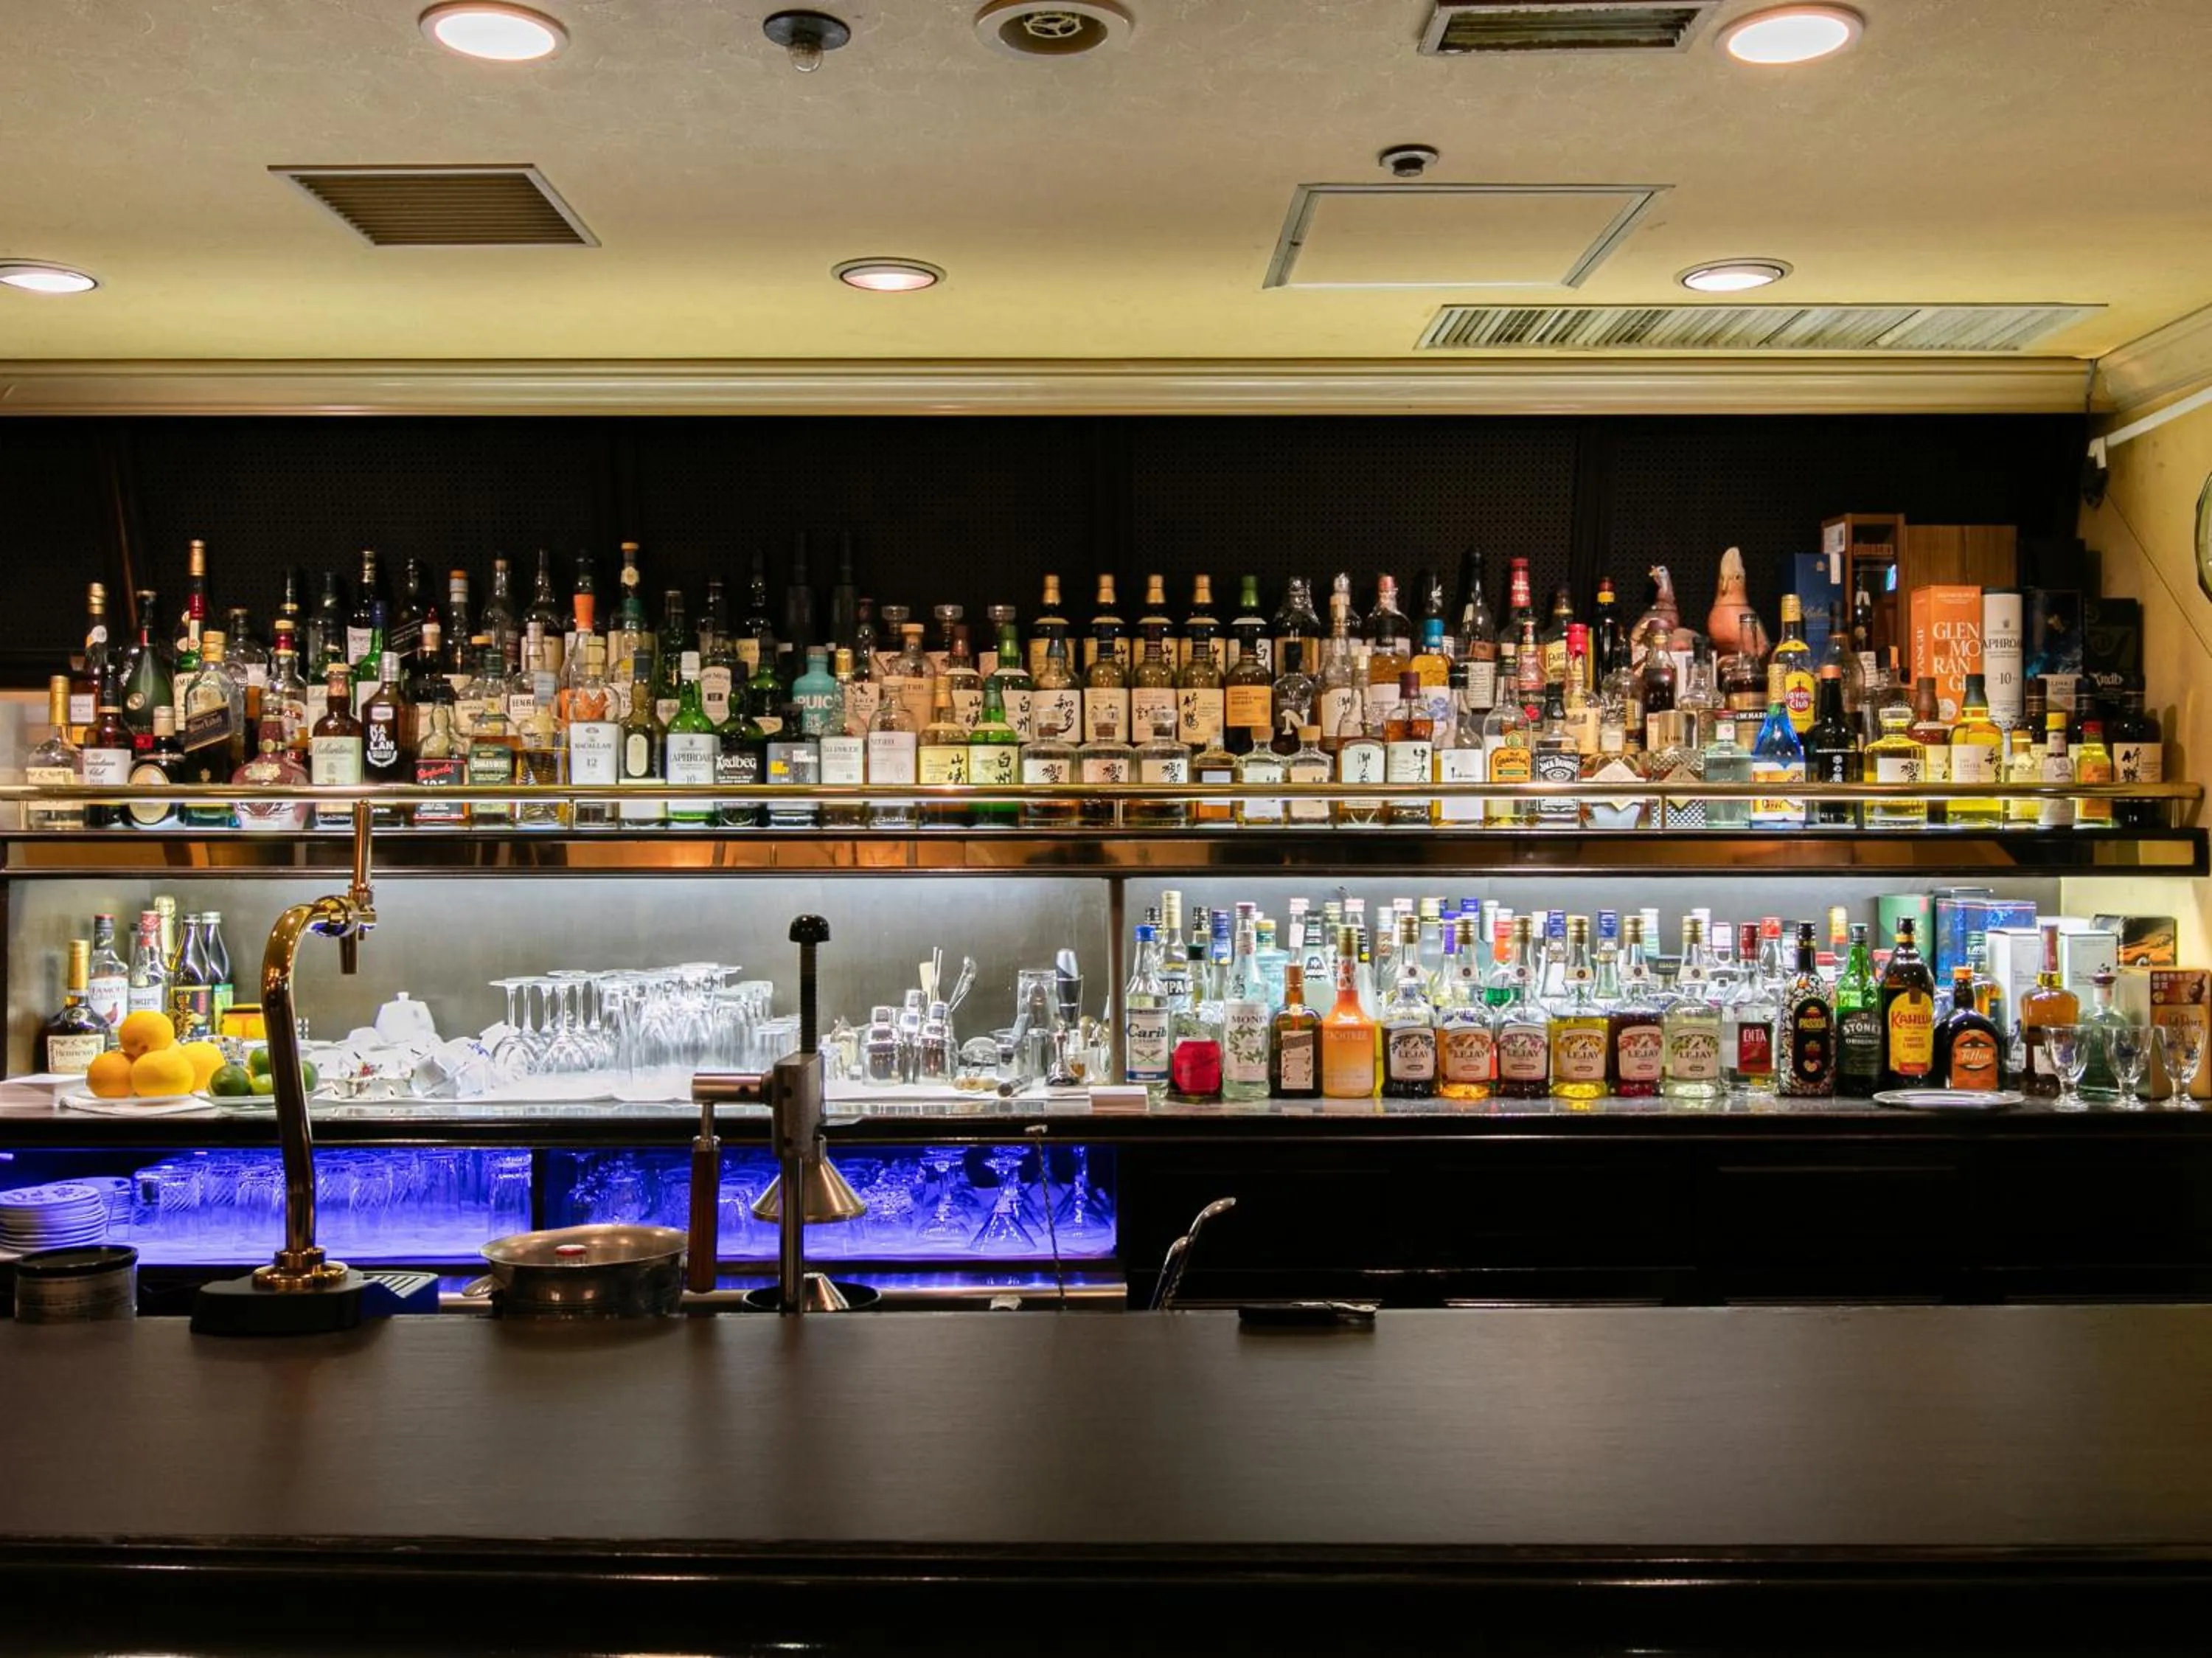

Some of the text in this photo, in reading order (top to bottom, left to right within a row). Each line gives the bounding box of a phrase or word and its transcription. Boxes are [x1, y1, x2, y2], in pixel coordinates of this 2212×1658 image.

[1933, 622, 1980, 639] GLEN
[1950, 639, 1981, 657] MO
[1933, 657, 1972, 674] RAN
[1999, 672, 2012, 685] 10
[1790, 698, 1809, 709] Club
[1281, 708, 1310, 735] N
[370, 740, 394, 750] LAN
[586, 758, 598, 768] 12
[1127, 1024, 1166, 1038] Carib
[1742, 1028, 1767, 1042] DITA
[1399, 1050, 1429, 1058] LEJAY
[1454, 1049, 1485, 1058] LEJAY
[1507, 1049, 1539, 1057] LEJAY
[1567, 1050, 1599, 1059] LEJAY
[1628, 1049, 1658, 1058] LEJAY
[1680, 1050, 1711, 1059] LEJAY
